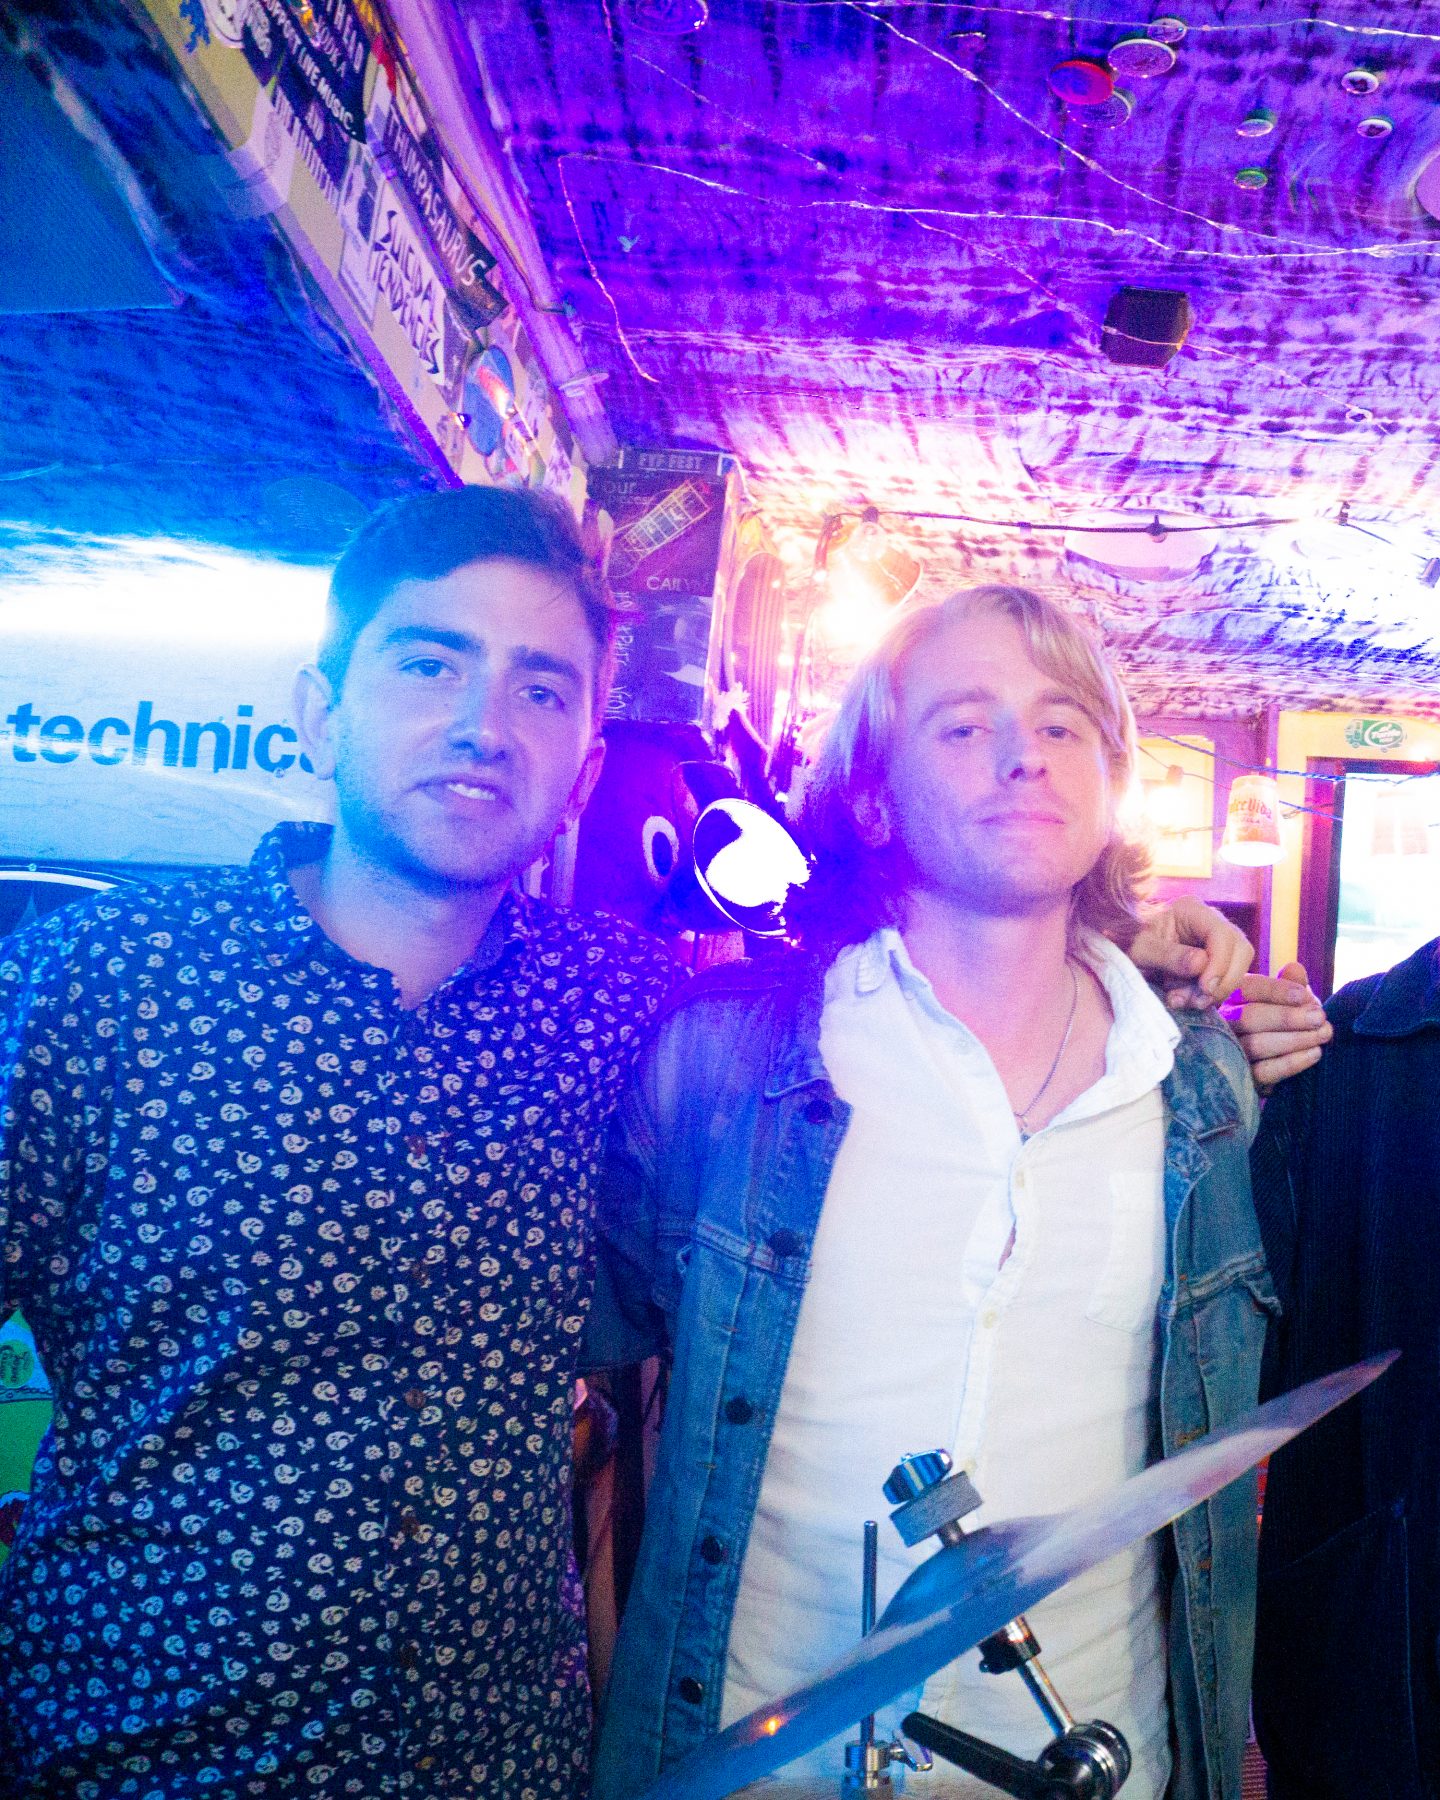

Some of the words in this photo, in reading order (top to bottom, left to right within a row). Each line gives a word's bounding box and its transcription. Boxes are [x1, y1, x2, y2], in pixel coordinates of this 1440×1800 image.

[265, 0, 302, 55] UPPORT
[298, 46, 320, 87] LIVE
[6, 700, 316, 774] technic
